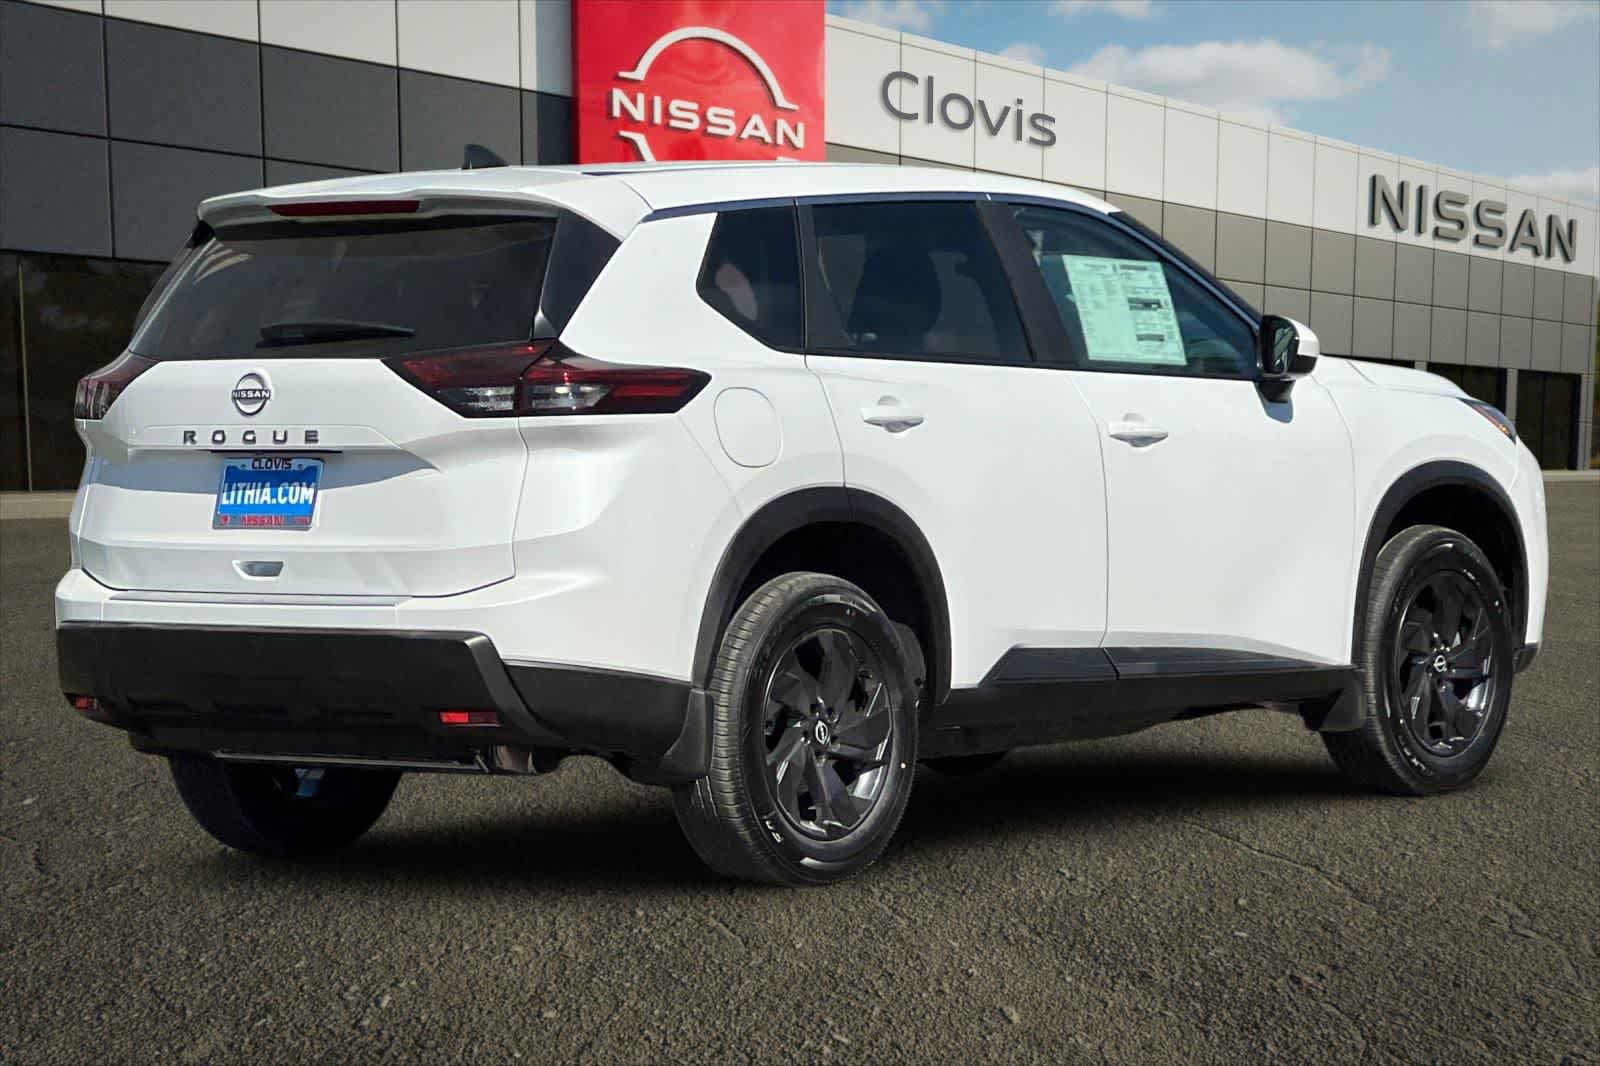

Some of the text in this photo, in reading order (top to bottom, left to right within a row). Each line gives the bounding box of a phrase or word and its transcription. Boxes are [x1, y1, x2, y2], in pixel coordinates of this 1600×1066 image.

[611, 87, 805, 149] NISSAN
[881, 70, 1057, 147] Clovis
[1368, 173, 1578, 263] NISSAN
[231, 389, 271, 399] NISSAN
[183, 429, 319, 444] ROGUE
[251, 458, 293, 470] CLOVIS
[221, 481, 316, 505] LITHIA.COM
